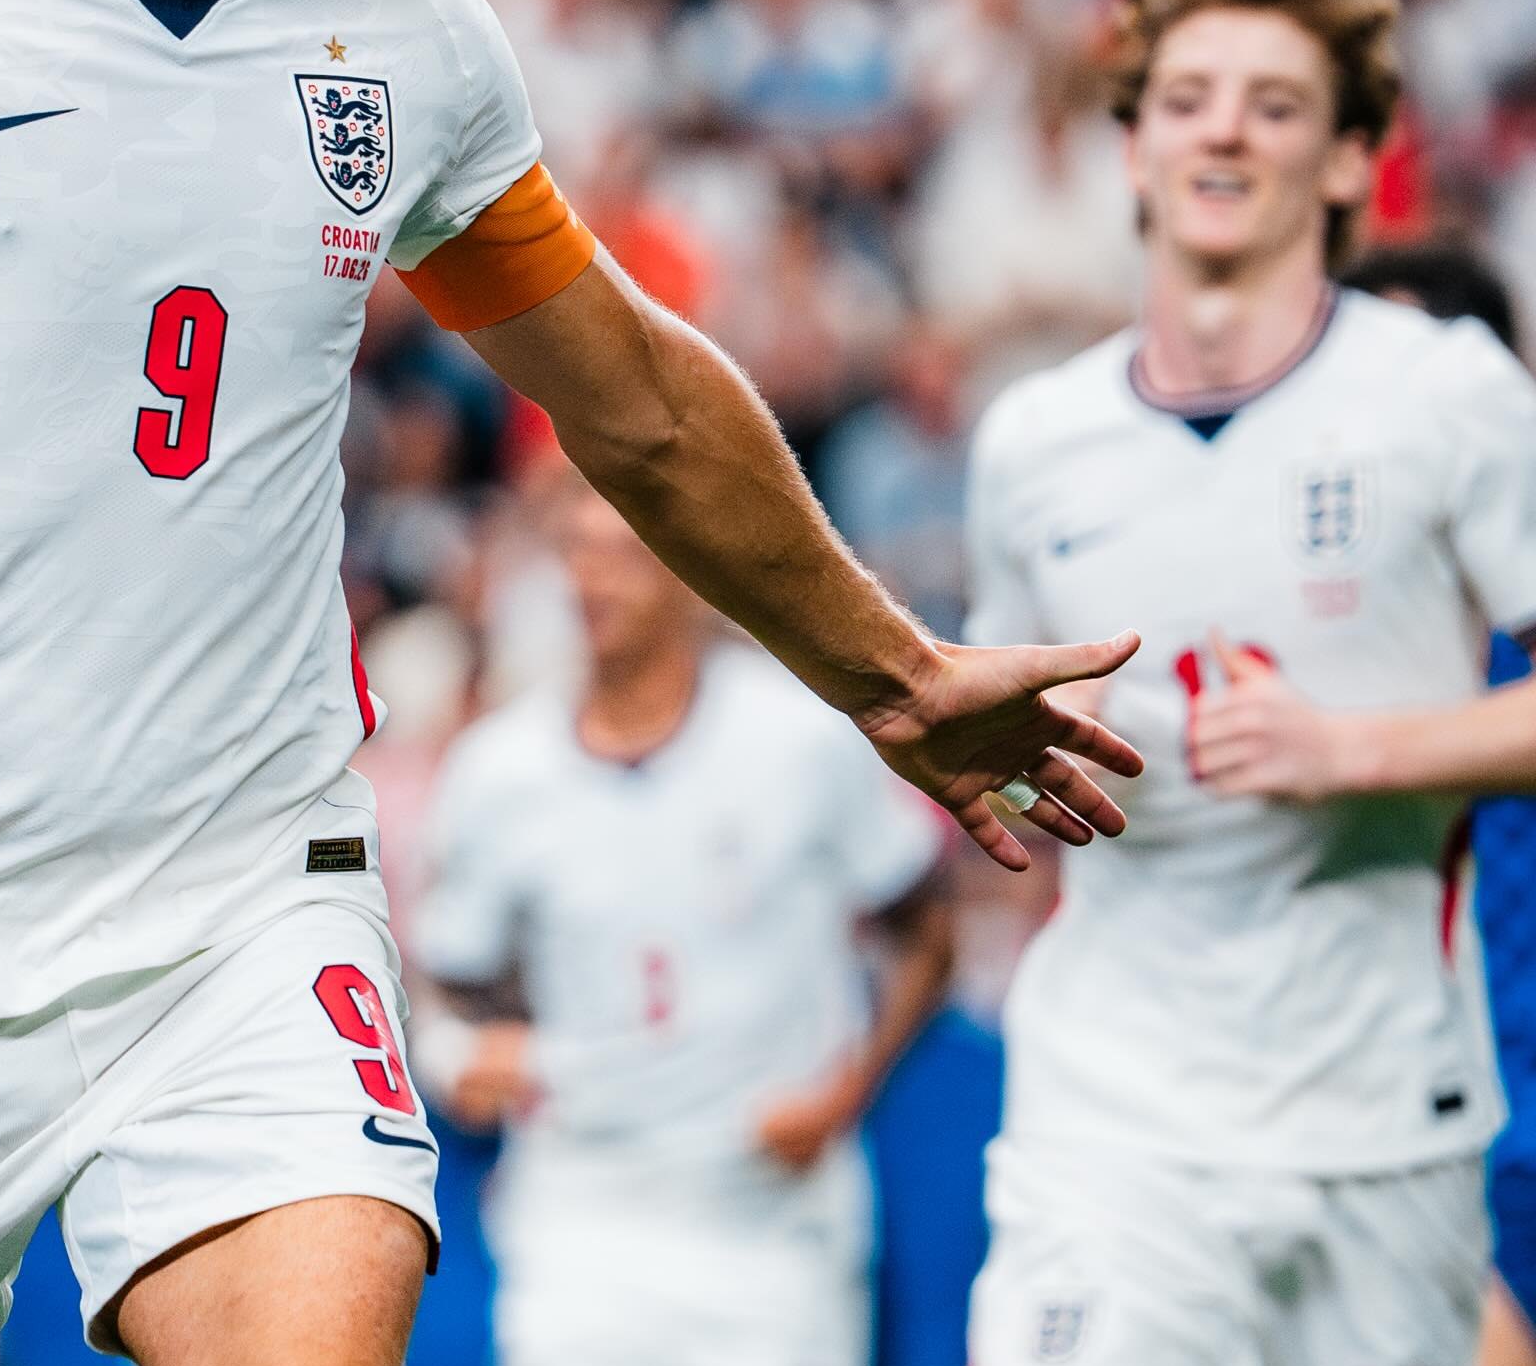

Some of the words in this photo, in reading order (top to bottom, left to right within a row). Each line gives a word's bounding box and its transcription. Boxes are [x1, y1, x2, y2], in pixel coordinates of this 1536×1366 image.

[321, 224, 381, 254] CROATIA
[133, 285, 229, 480] 9
[312, 963, 417, 1117] 9
